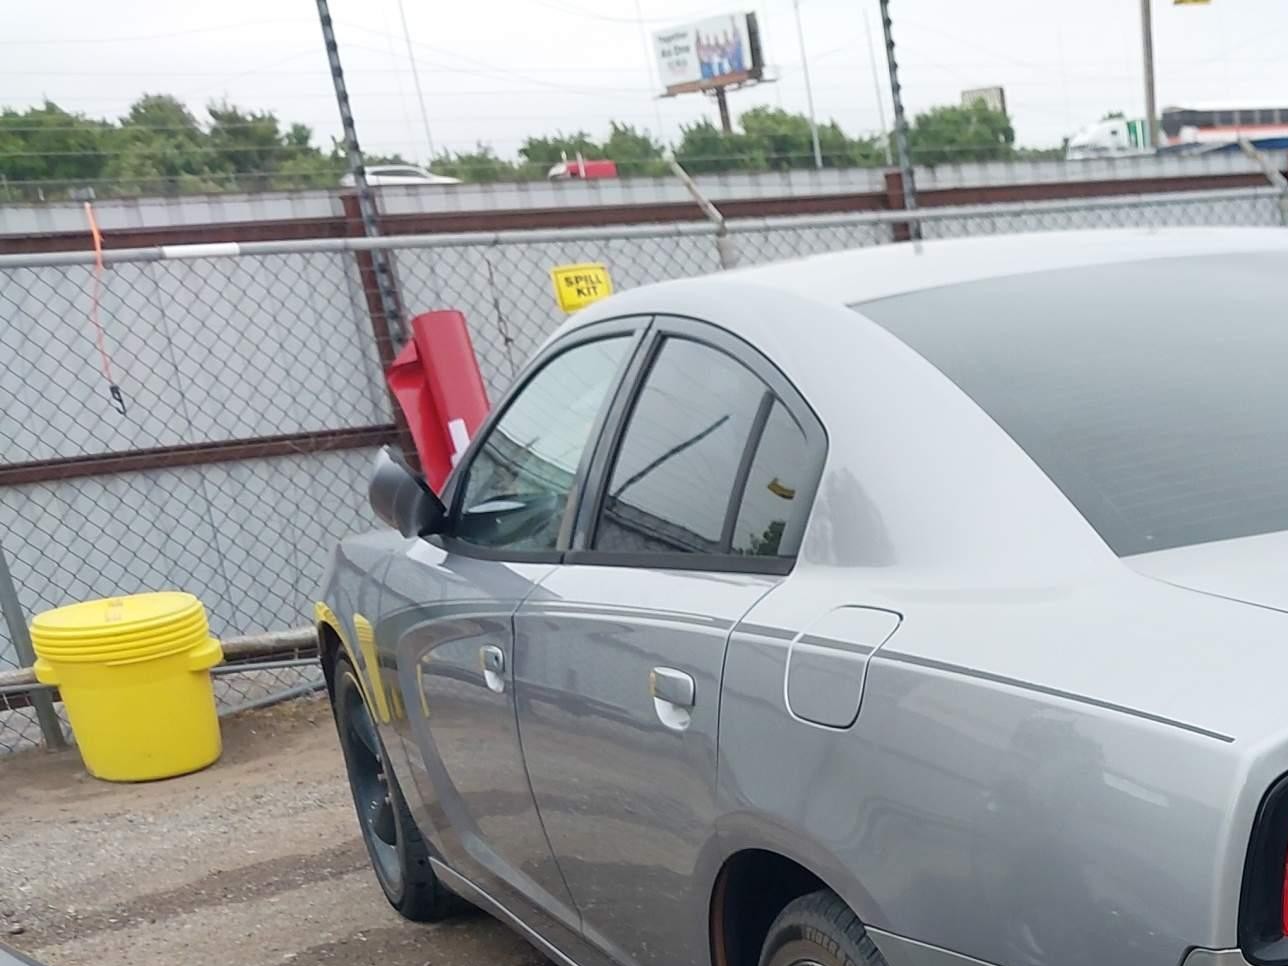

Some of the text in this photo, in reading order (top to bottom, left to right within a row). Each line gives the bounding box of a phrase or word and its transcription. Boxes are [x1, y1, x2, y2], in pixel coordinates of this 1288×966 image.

[564, 274, 602, 288] SPILL
[576, 286, 599, 298] KIT
[805, 926, 840, 959] TIGER
